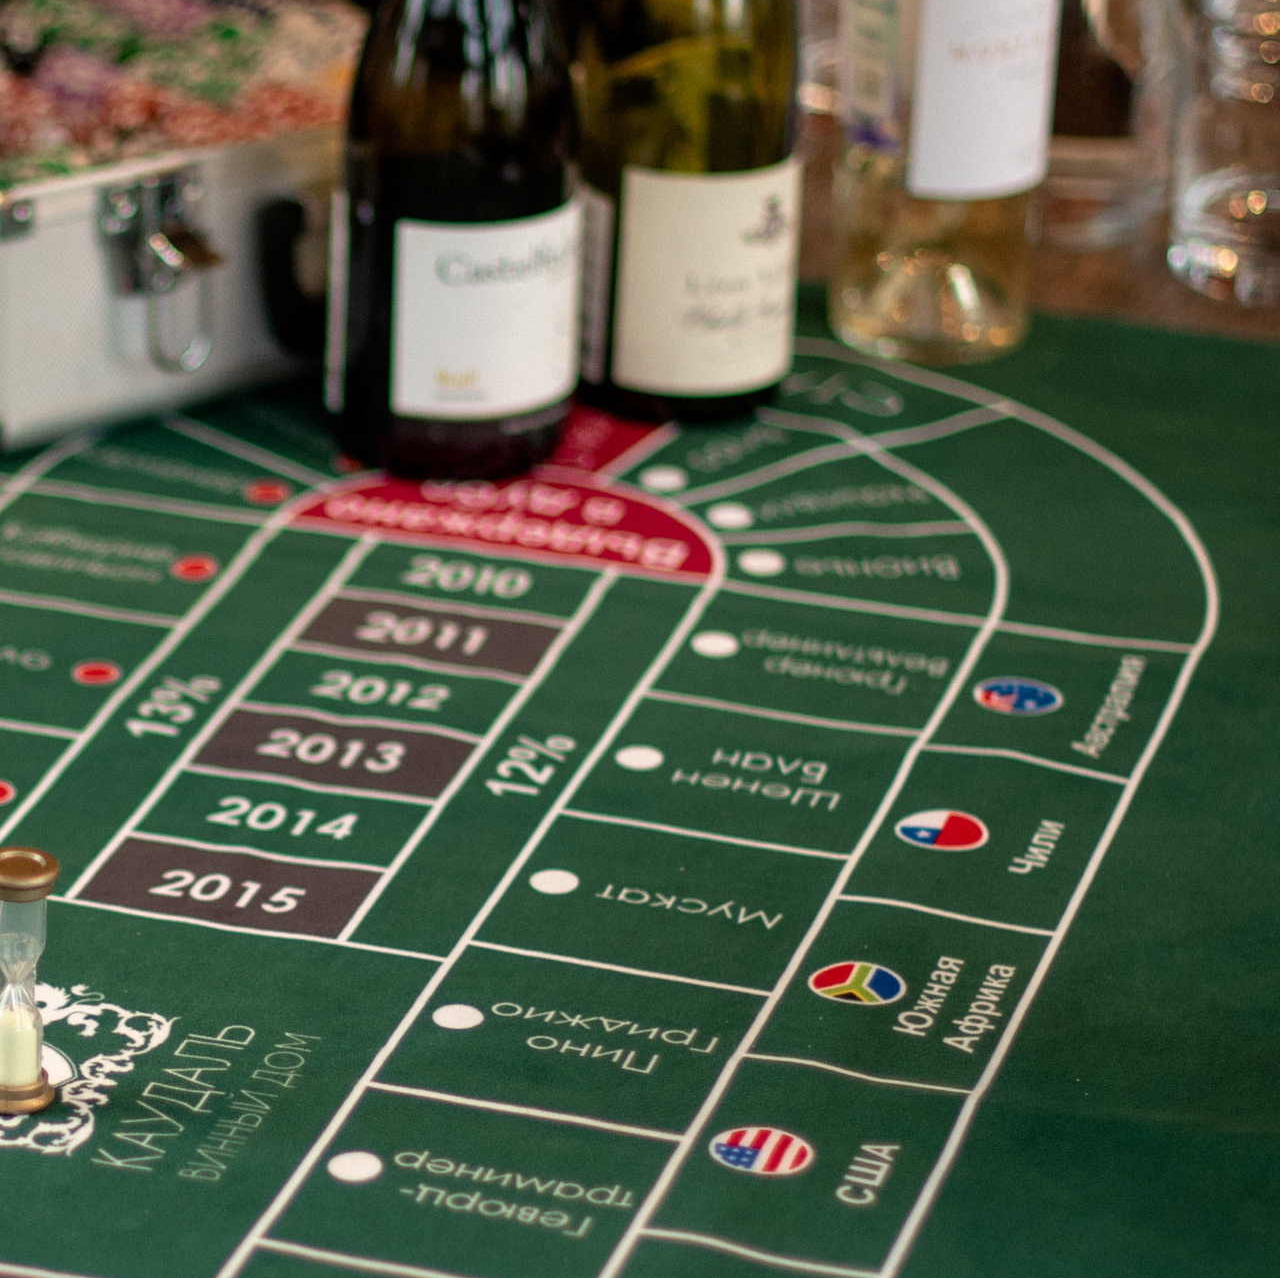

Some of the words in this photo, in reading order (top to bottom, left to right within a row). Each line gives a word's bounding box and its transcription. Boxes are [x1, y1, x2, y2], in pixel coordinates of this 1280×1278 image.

[400, 554, 533, 599] 2010
[354, 609, 491, 656] 2011
[125, 673, 221, 740] 13%
[309, 669, 451, 712] 2012
[1070, 653, 1148, 759] Австралия
[255, 726, 407, 774] 2013
[484, 733, 578, 800] 12%
[710, 747, 829, 784] Блан
[670, 767, 843, 812] Шенен
[205, 796, 359, 840] 2014
[1006, 817, 1066, 876] Чили
[147, 867, 307, 914] 2015
[595, 885, 785, 930] Мускат
[892, 955, 965, 1038] Южная
[942, 962, 1017, 1054] Африка
[490, 1000, 720, 1055] Гриджио
[525, 1033, 660, 1075] Пино
[90, 1024, 257, 1172] КАУДАЛЬ
[178, 1082, 280, 1183] ВИННЫЙ
[261, 1030, 322, 1090] ДОМ
[393, 1149, 637, 1209] траминер
[835, 1140, 902, 1206] США
[397, 1183, 594, 1239] Гевюрц-
